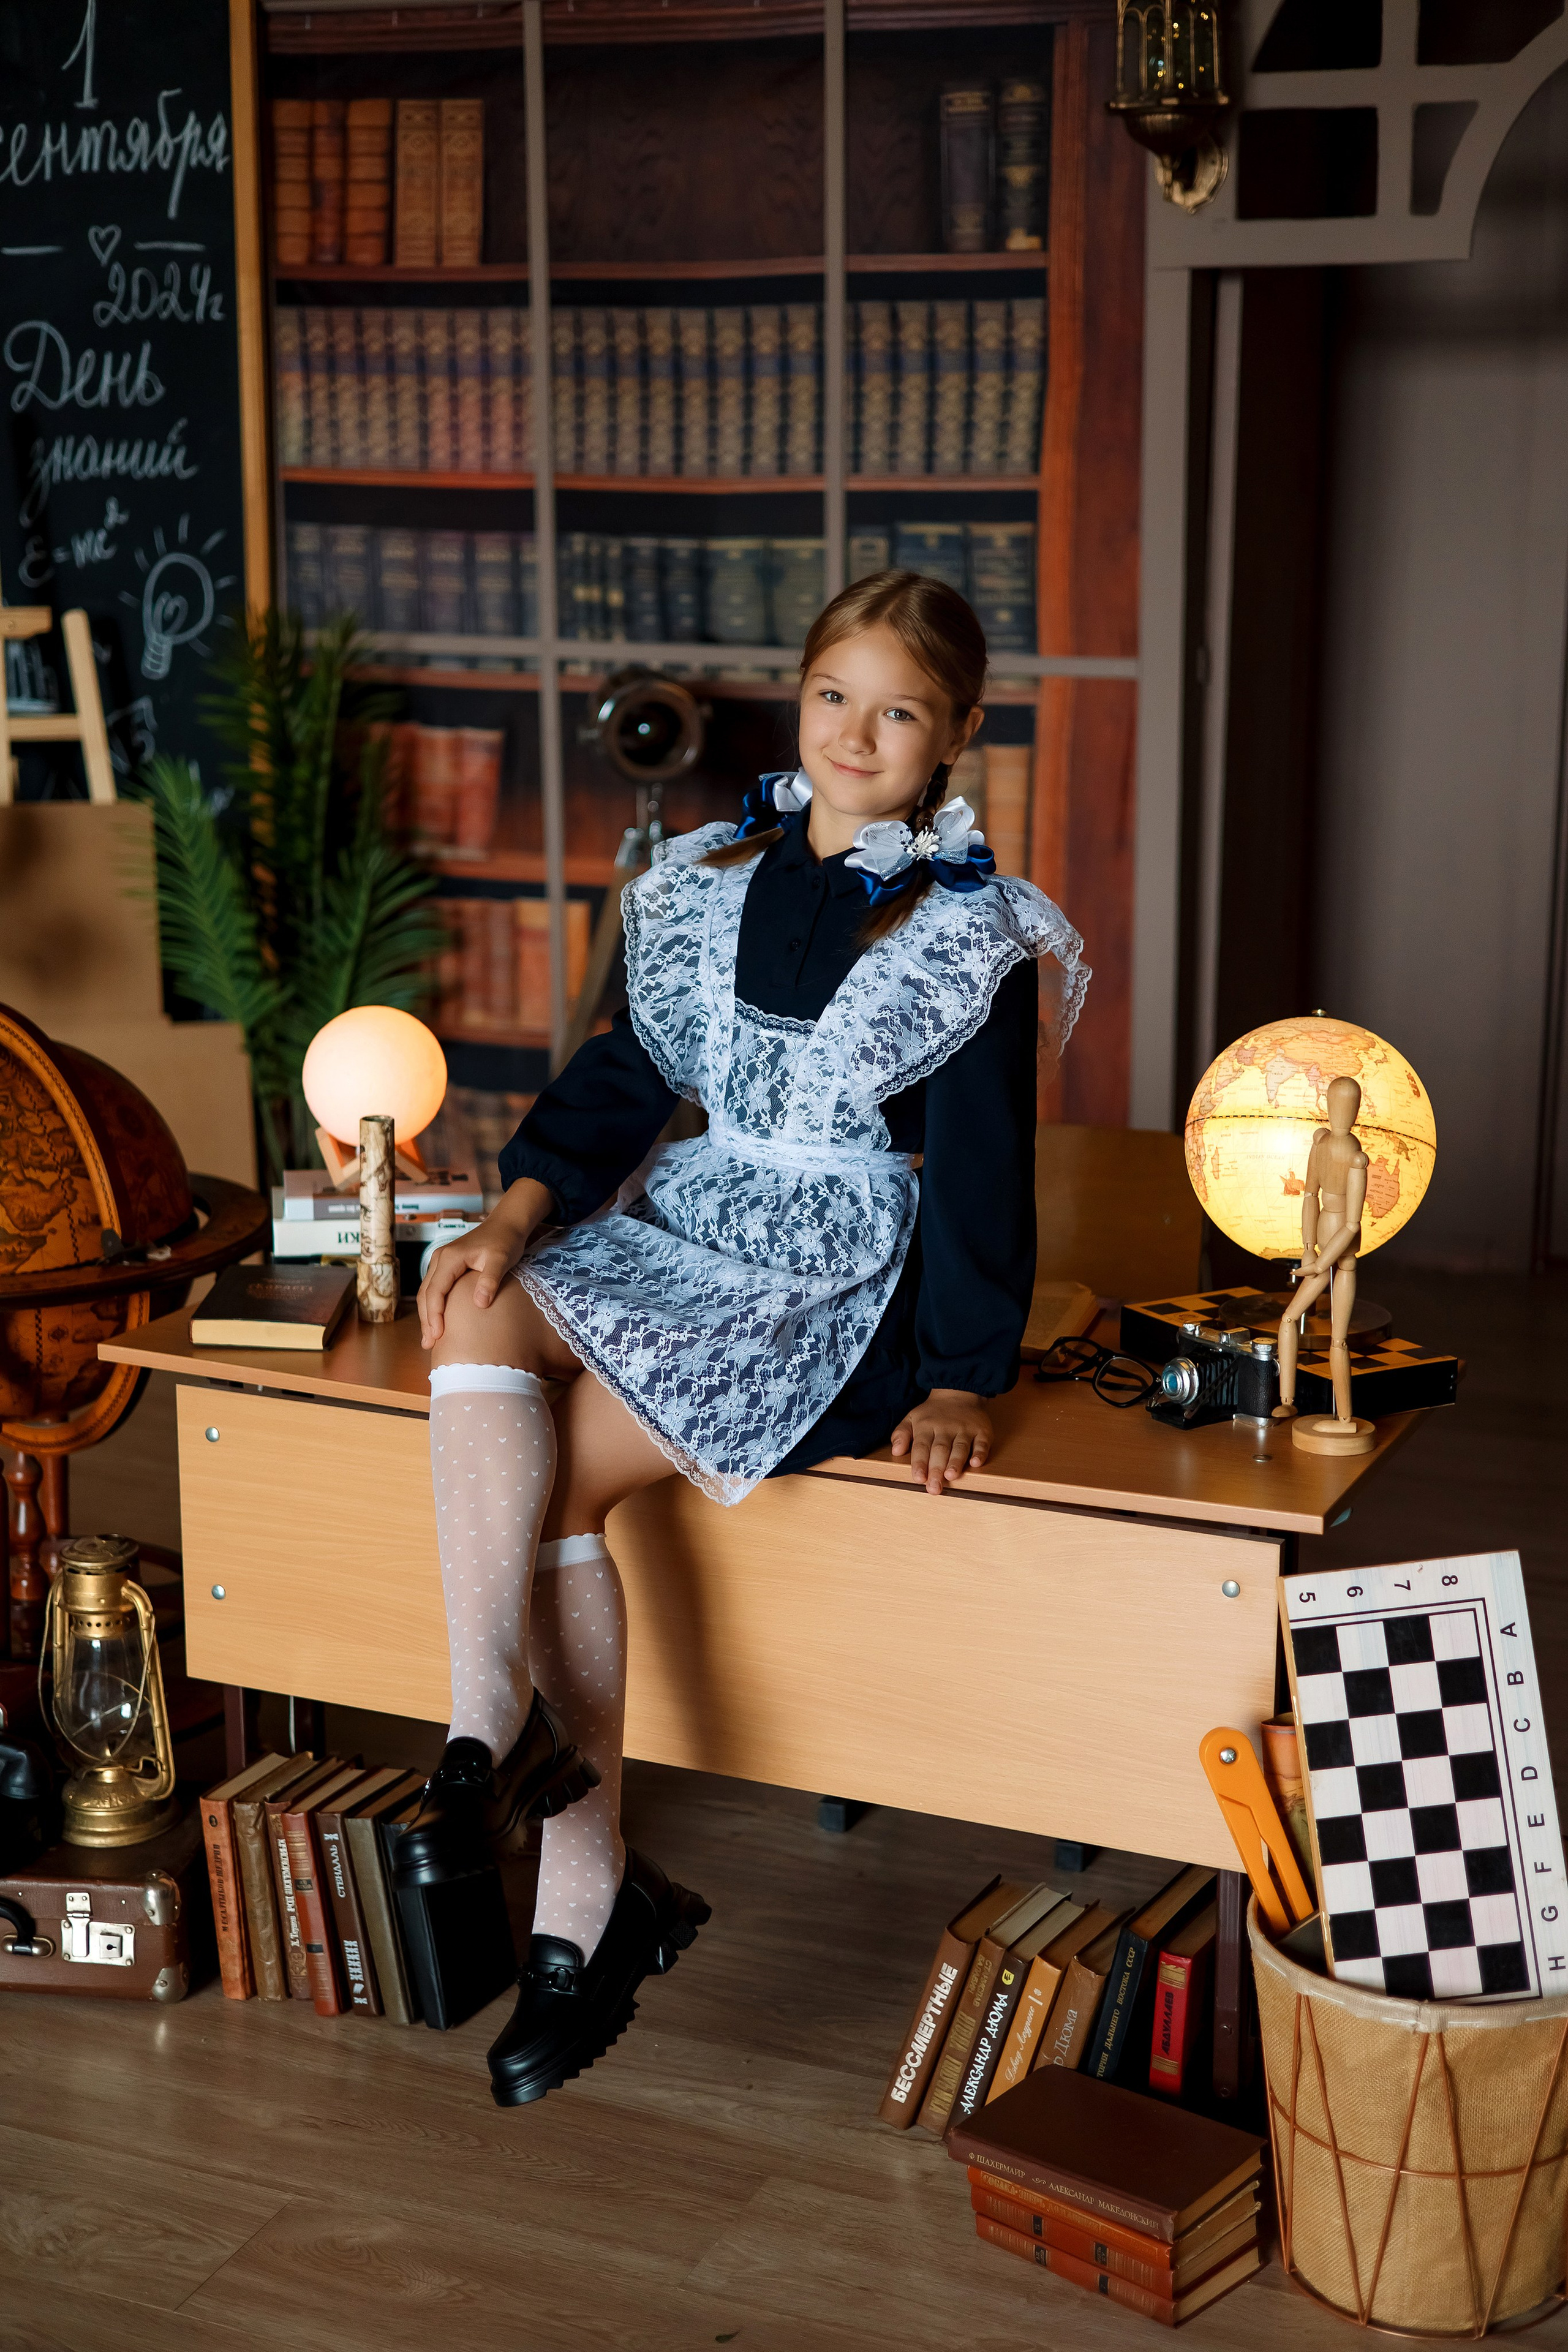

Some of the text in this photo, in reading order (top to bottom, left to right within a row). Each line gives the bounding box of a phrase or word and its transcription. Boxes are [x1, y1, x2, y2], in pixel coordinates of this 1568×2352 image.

[62, 0, 99, 109] 1
[0, 88, 232, 220] ентября
[4, 319, 166, 412] День
[19, 417, 199, 528] знаний
[1299, 1575, 1458, 1603] 5 6 7 8
[1500, 1621, 1566, 1971] A B C D E F G H
[330, 1844, 346, 1898] СТЕНДАЛЬ
[891, 1962, 958, 2103] БЕССМЕРТНЫЕ
[960, 1993, 1009, 2114] АЛЕКСАНДР ДЮМА
[1005, 2005, 1035, 2083] Дэвид Лоуренс
[1054, 2009, 1078, 2057] Дюма
[1096, 1947, 1136, 2078] ТОРИЯ ДАЛЬНЕГО ВОСТОКА СССР
[1161, 1992, 1174, 2056] АБДУЛЛАЕВ
[969, 2152, 976, 2160] Ф.
[1049, 2182, 1095, 2205] АЛЕКСАНДР
[1098, 2199, 1159, 2231] МАКЕДОНСКИЙ
